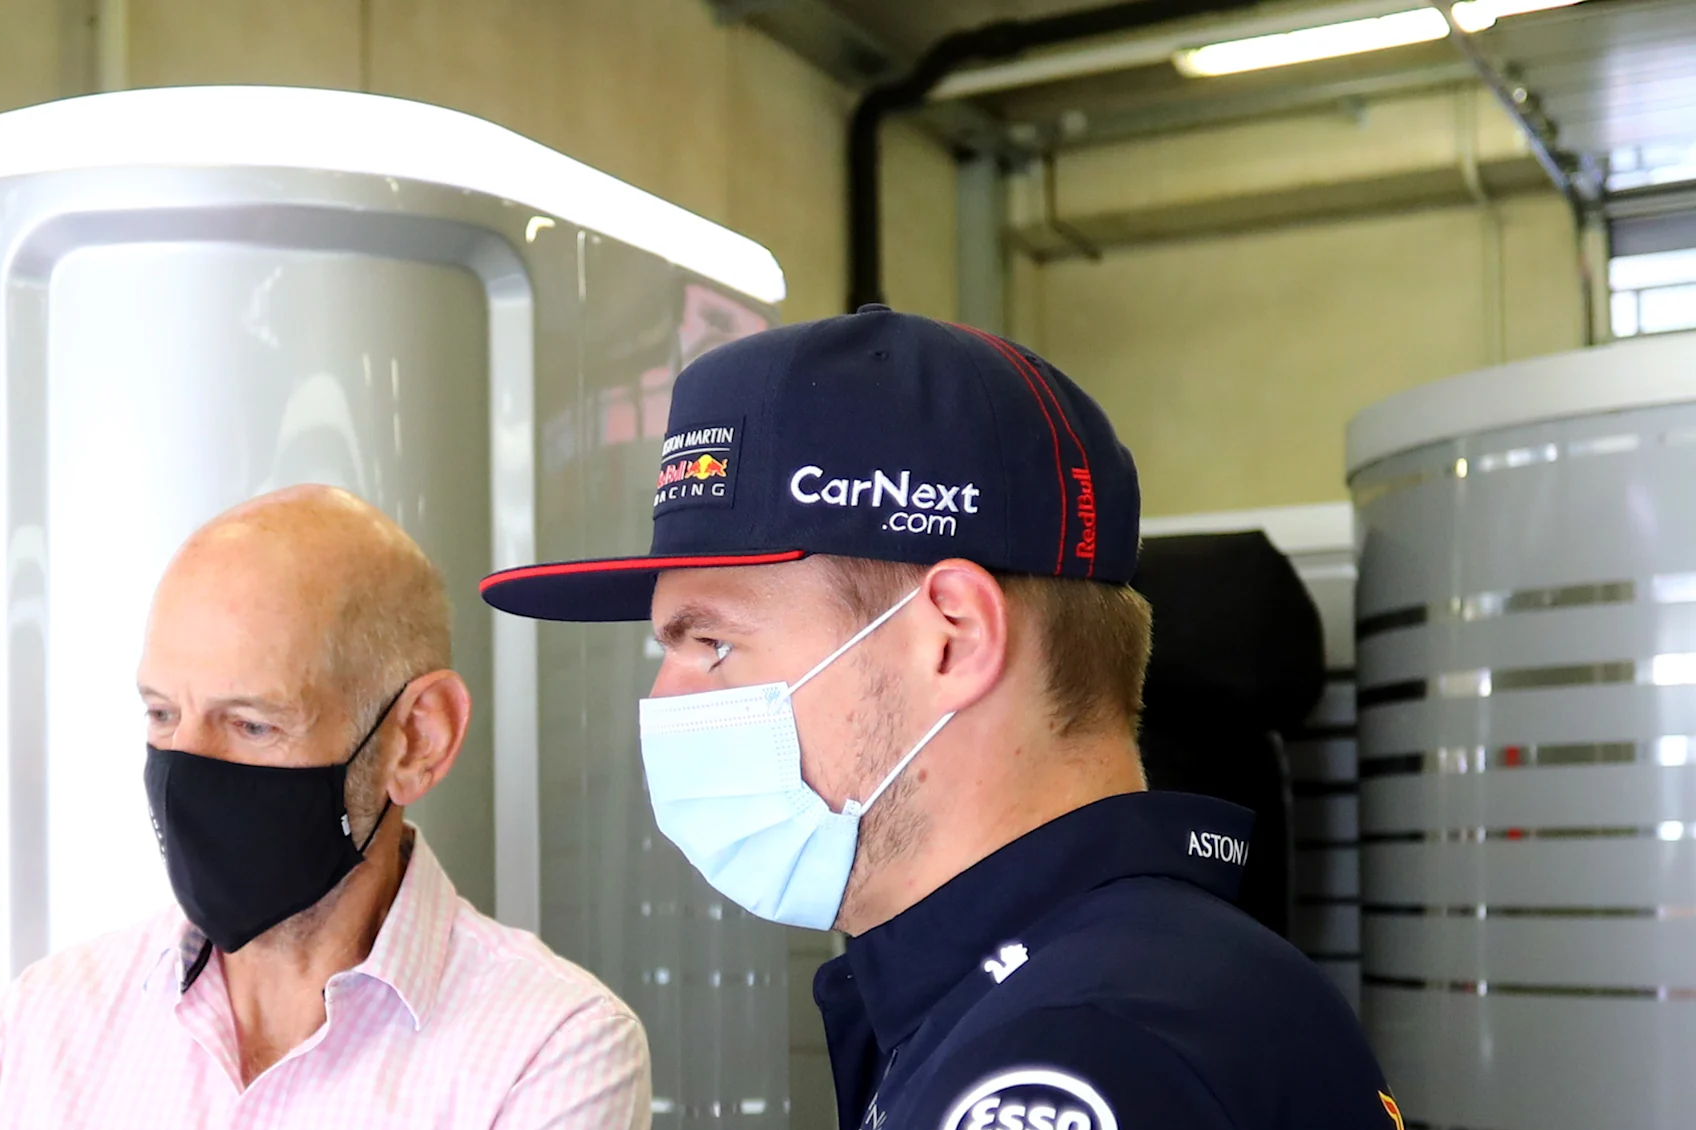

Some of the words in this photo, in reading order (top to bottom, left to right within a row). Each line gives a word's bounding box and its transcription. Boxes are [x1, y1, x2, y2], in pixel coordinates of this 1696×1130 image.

[685, 427, 734, 447] MARTIN
[790, 465, 980, 513] CarNext
[882, 511, 957, 536] .com
[1187, 830, 1245, 866] ASTON
